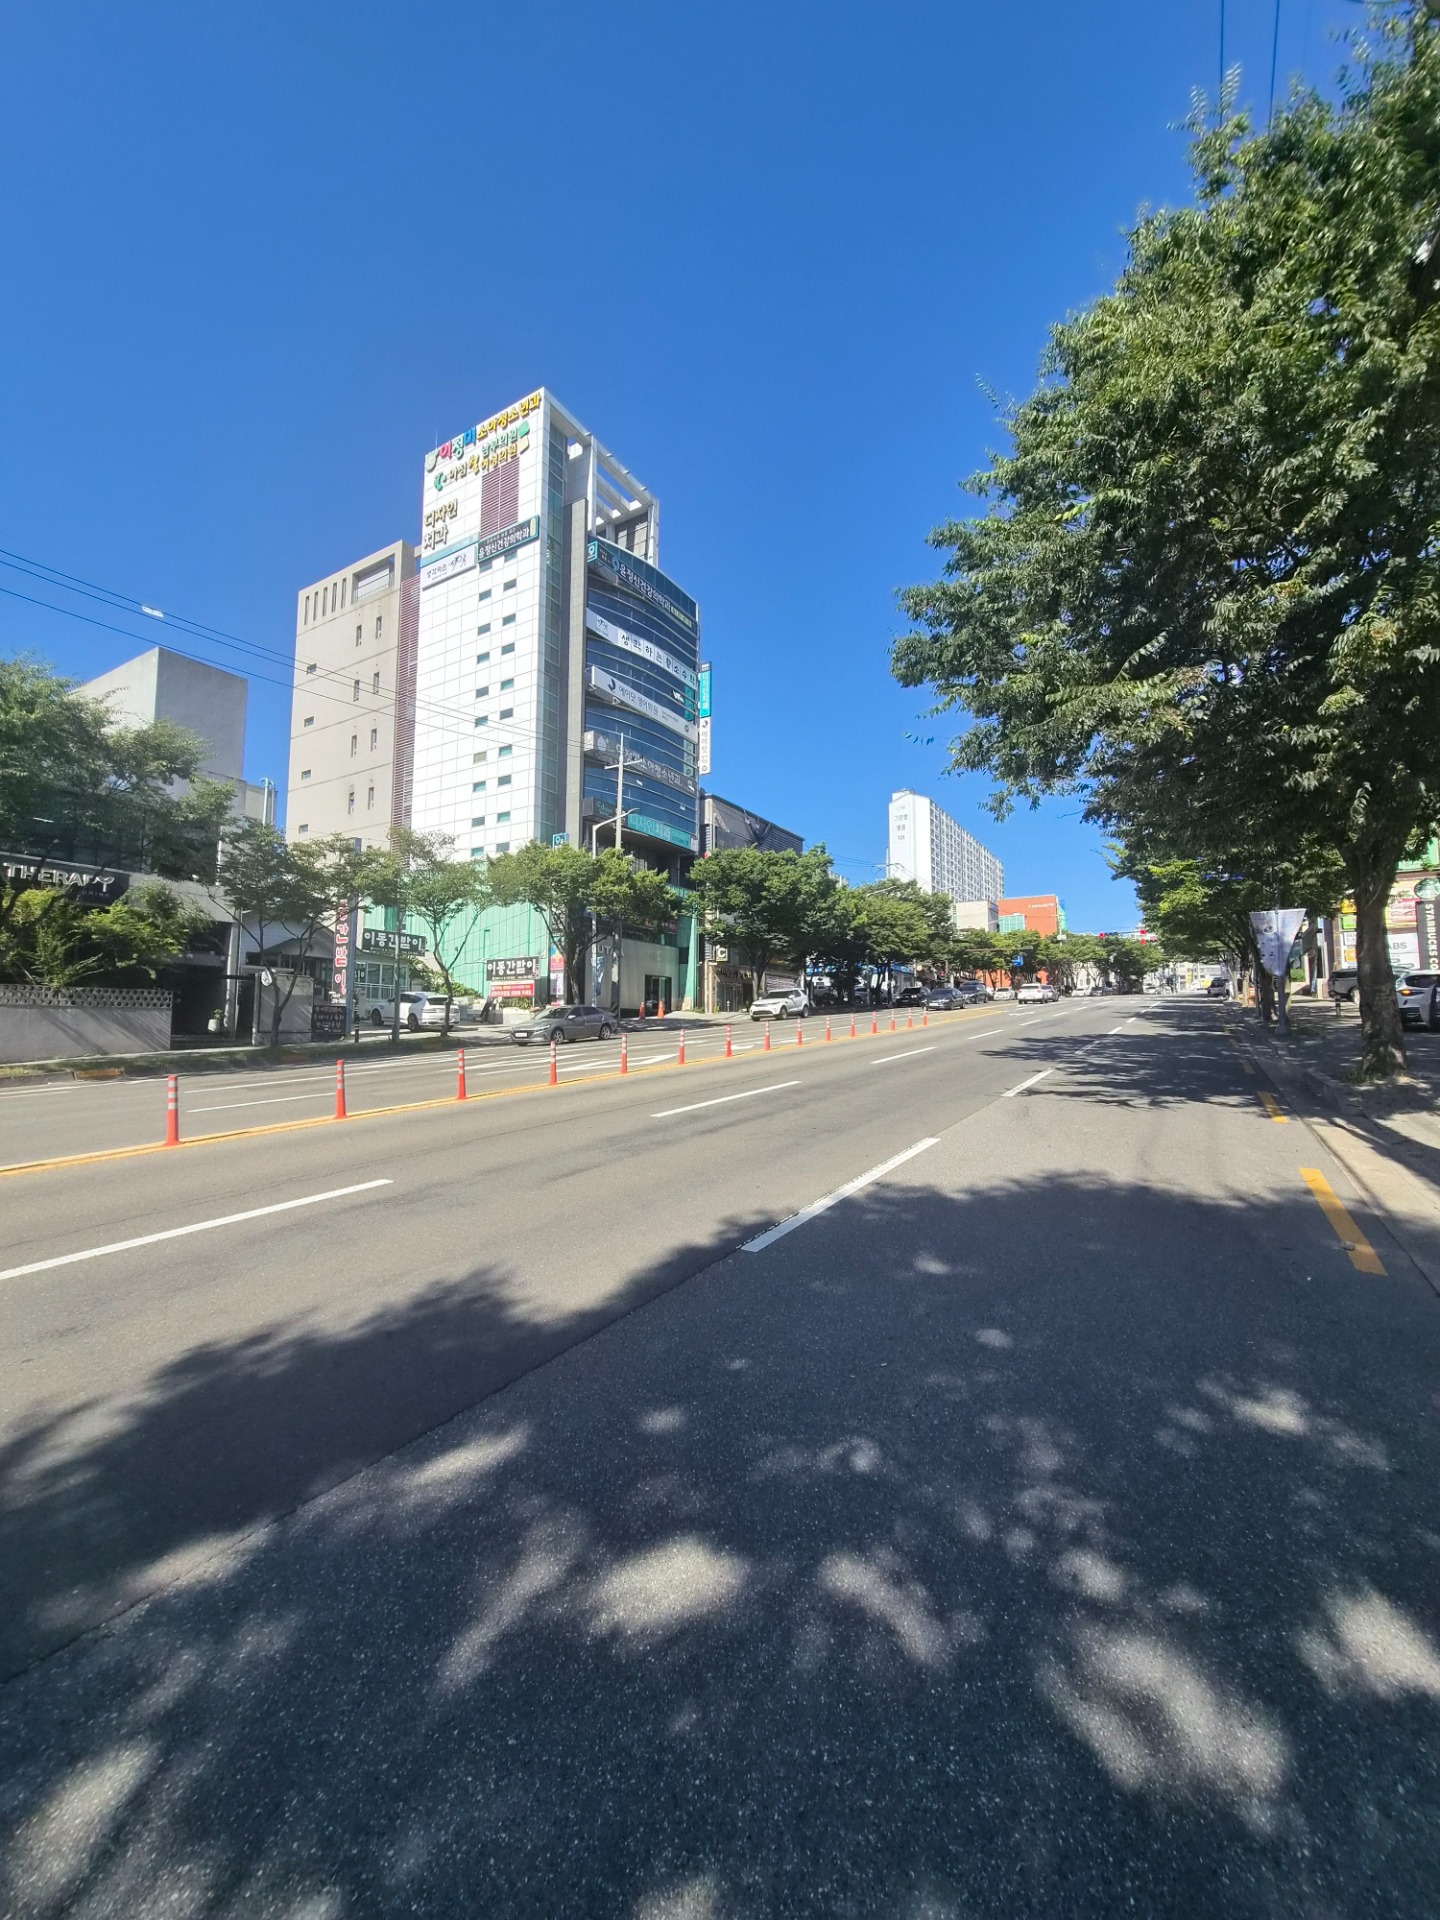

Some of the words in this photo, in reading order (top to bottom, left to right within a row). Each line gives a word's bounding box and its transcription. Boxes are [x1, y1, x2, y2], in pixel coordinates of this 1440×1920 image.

[438, 426, 477, 460] 이정미
[476, 393, 542, 441] 소아청소년과
[424, 498, 458, 528] 디자인
[424, 524, 449, 550] 치과
[479, 526, 530, 559] 윤정신건강의학과
[620, 563, 671, 612] 윤정신건강의학과
[1425, 903, 1438, 957] STARBUCKS
[717, 947, 726, 958] C
